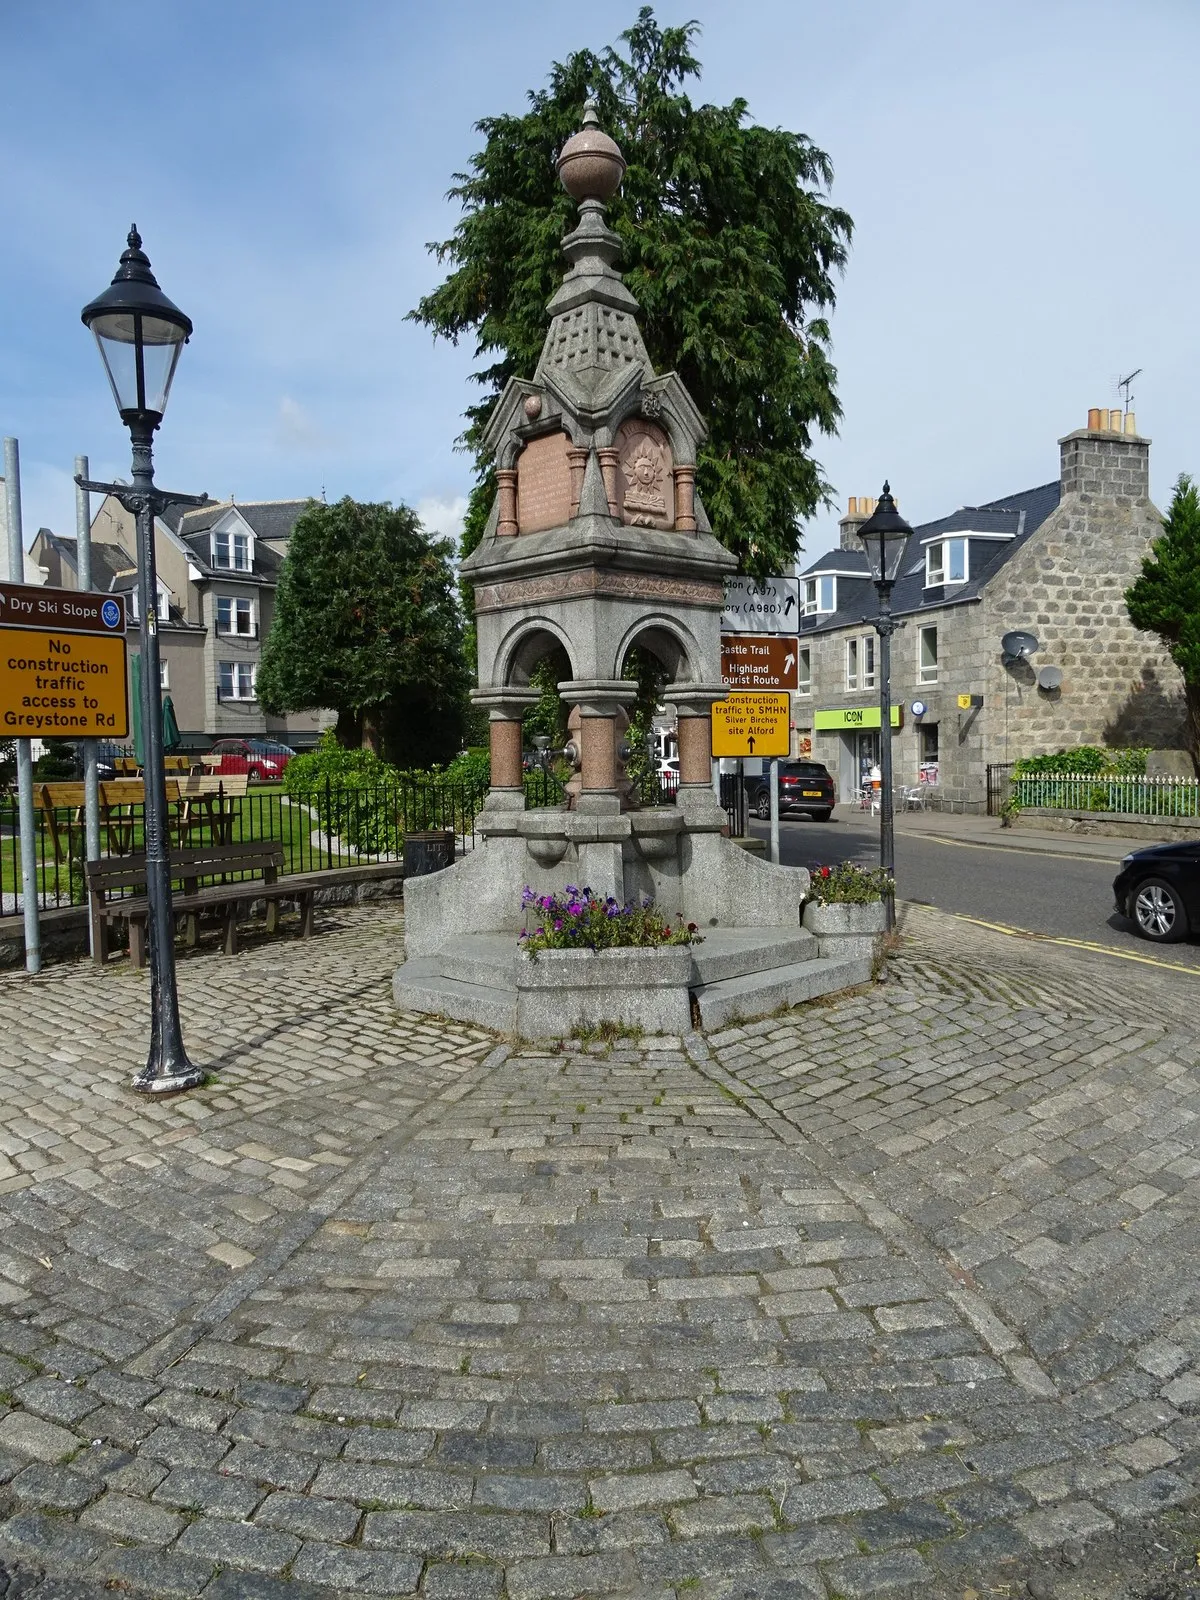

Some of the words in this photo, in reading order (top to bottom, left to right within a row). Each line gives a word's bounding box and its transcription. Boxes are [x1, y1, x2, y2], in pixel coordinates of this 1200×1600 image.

[747, 586, 776, 597] (A97)
[10, 598, 33, 614] Dry
[38, 601, 58, 614] Ski
[63, 603, 98, 618] Slope
[744, 602, 782, 614] (A980)
[49, 640, 71, 654] No
[720, 644, 748, 654] Castle
[750, 646, 770, 655] Trail
[8, 658, 108, 674] construction
[729, 664, 768, 674] Highland
[36, 676, 85, 691] traffic
[720, 675, 750, 684] Tourist
[754, 676, 779, 684] Route
[22, 696, 76, 707] access
[83, 696, 98, 709] to
[716, 706, 742, 714] traffic
[759, 706, 786, 714] SMHN
[4, 711, 88, 728] Greystone
[96, 713, 115, 726] Rd
[844, 711, 863, 722] ICON
